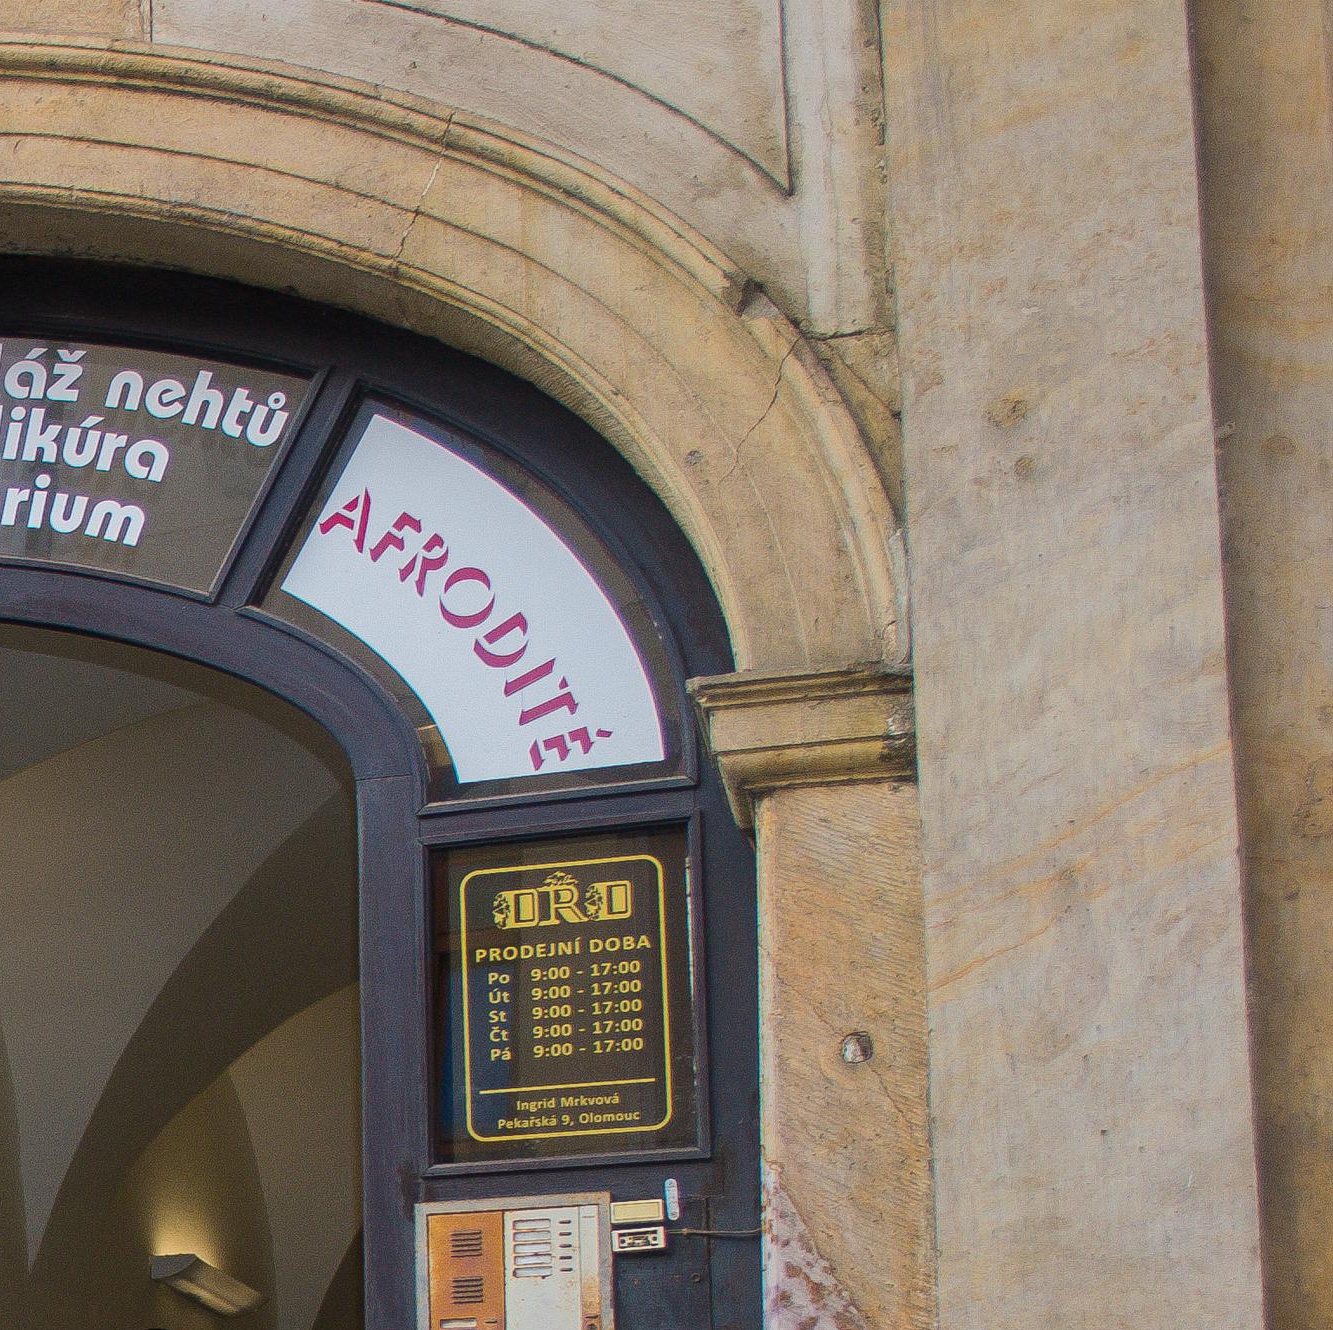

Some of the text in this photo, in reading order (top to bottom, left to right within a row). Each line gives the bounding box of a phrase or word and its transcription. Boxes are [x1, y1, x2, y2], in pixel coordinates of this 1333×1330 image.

[104, 370, 289, 447] nehtů
[475, 934, 652, 962] PRODEJNÍ DOBA
[488, 960, 641, 985] Po 9:00 17:00
[488, 979, 642, 1004] Út 9:00 17:00
[489, 999, 642, 1023] St 9:00 17:00
[490, 1018, 643, 1042] Čt 9:00 17:00
[490, 1038, 644, 1061] Pá 9:00 17:00
[516, 1092, 620, 1113] Ingrid Mrkvová
[498, 1110, 641, 1130] Pekařská 9, Olomouc
